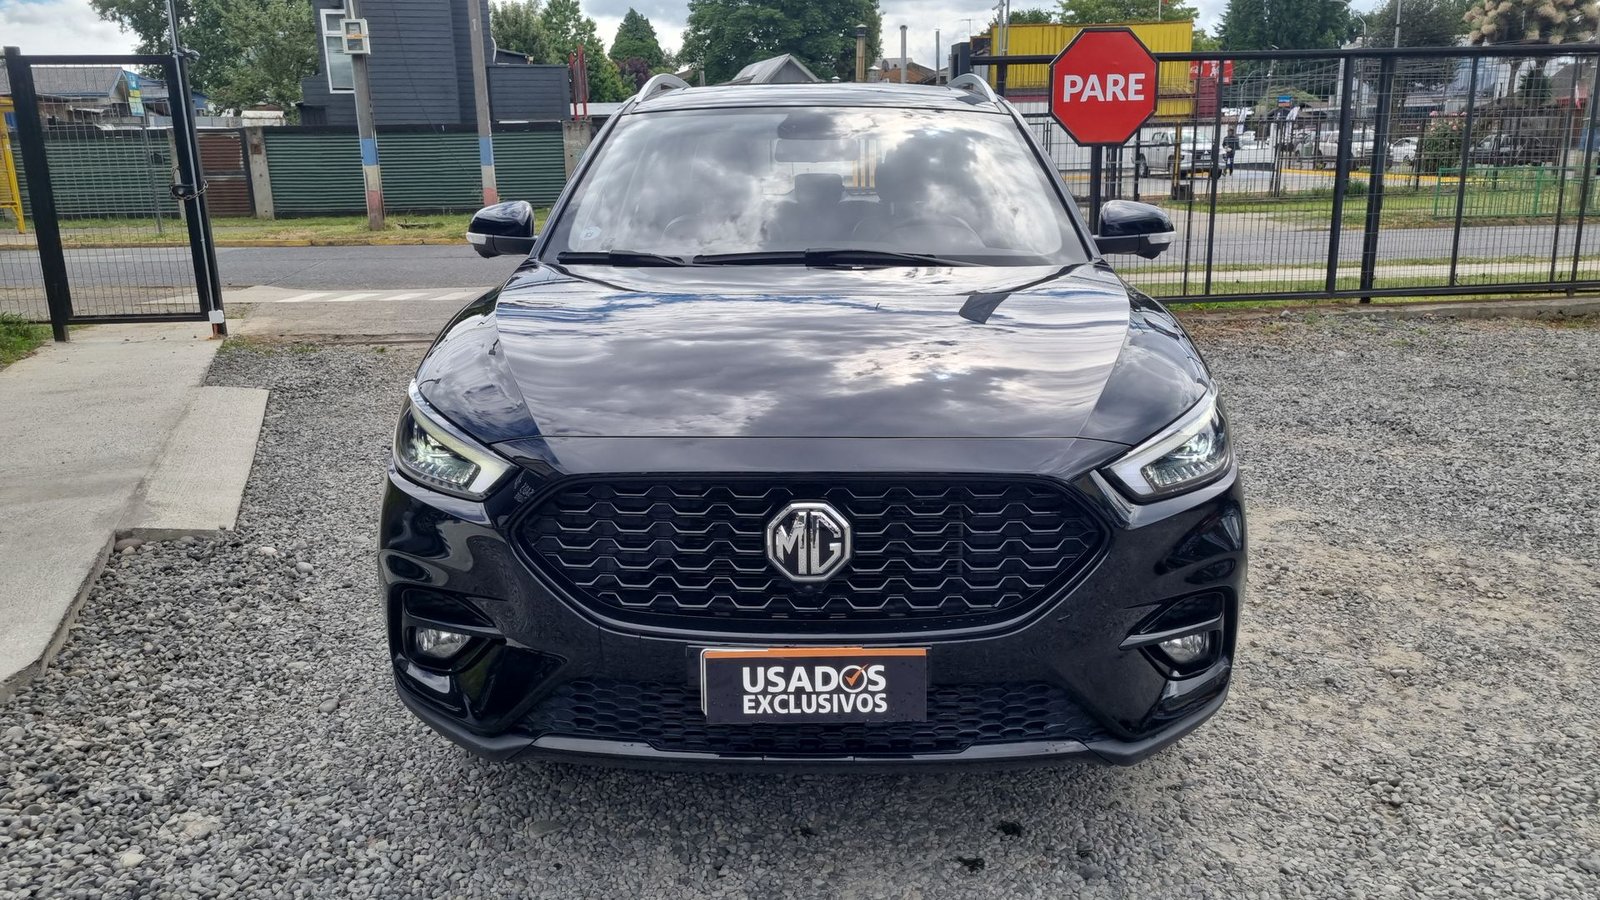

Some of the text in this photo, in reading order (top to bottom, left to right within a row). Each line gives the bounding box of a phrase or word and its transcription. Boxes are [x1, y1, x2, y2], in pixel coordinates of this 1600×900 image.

[1063, 73, 1145, 103] PARE
[776, 511, 842, 575] MG
[742, 664, 887, 693] USADOS
[743, 693, 888, 714] EXCLUSIVOS
